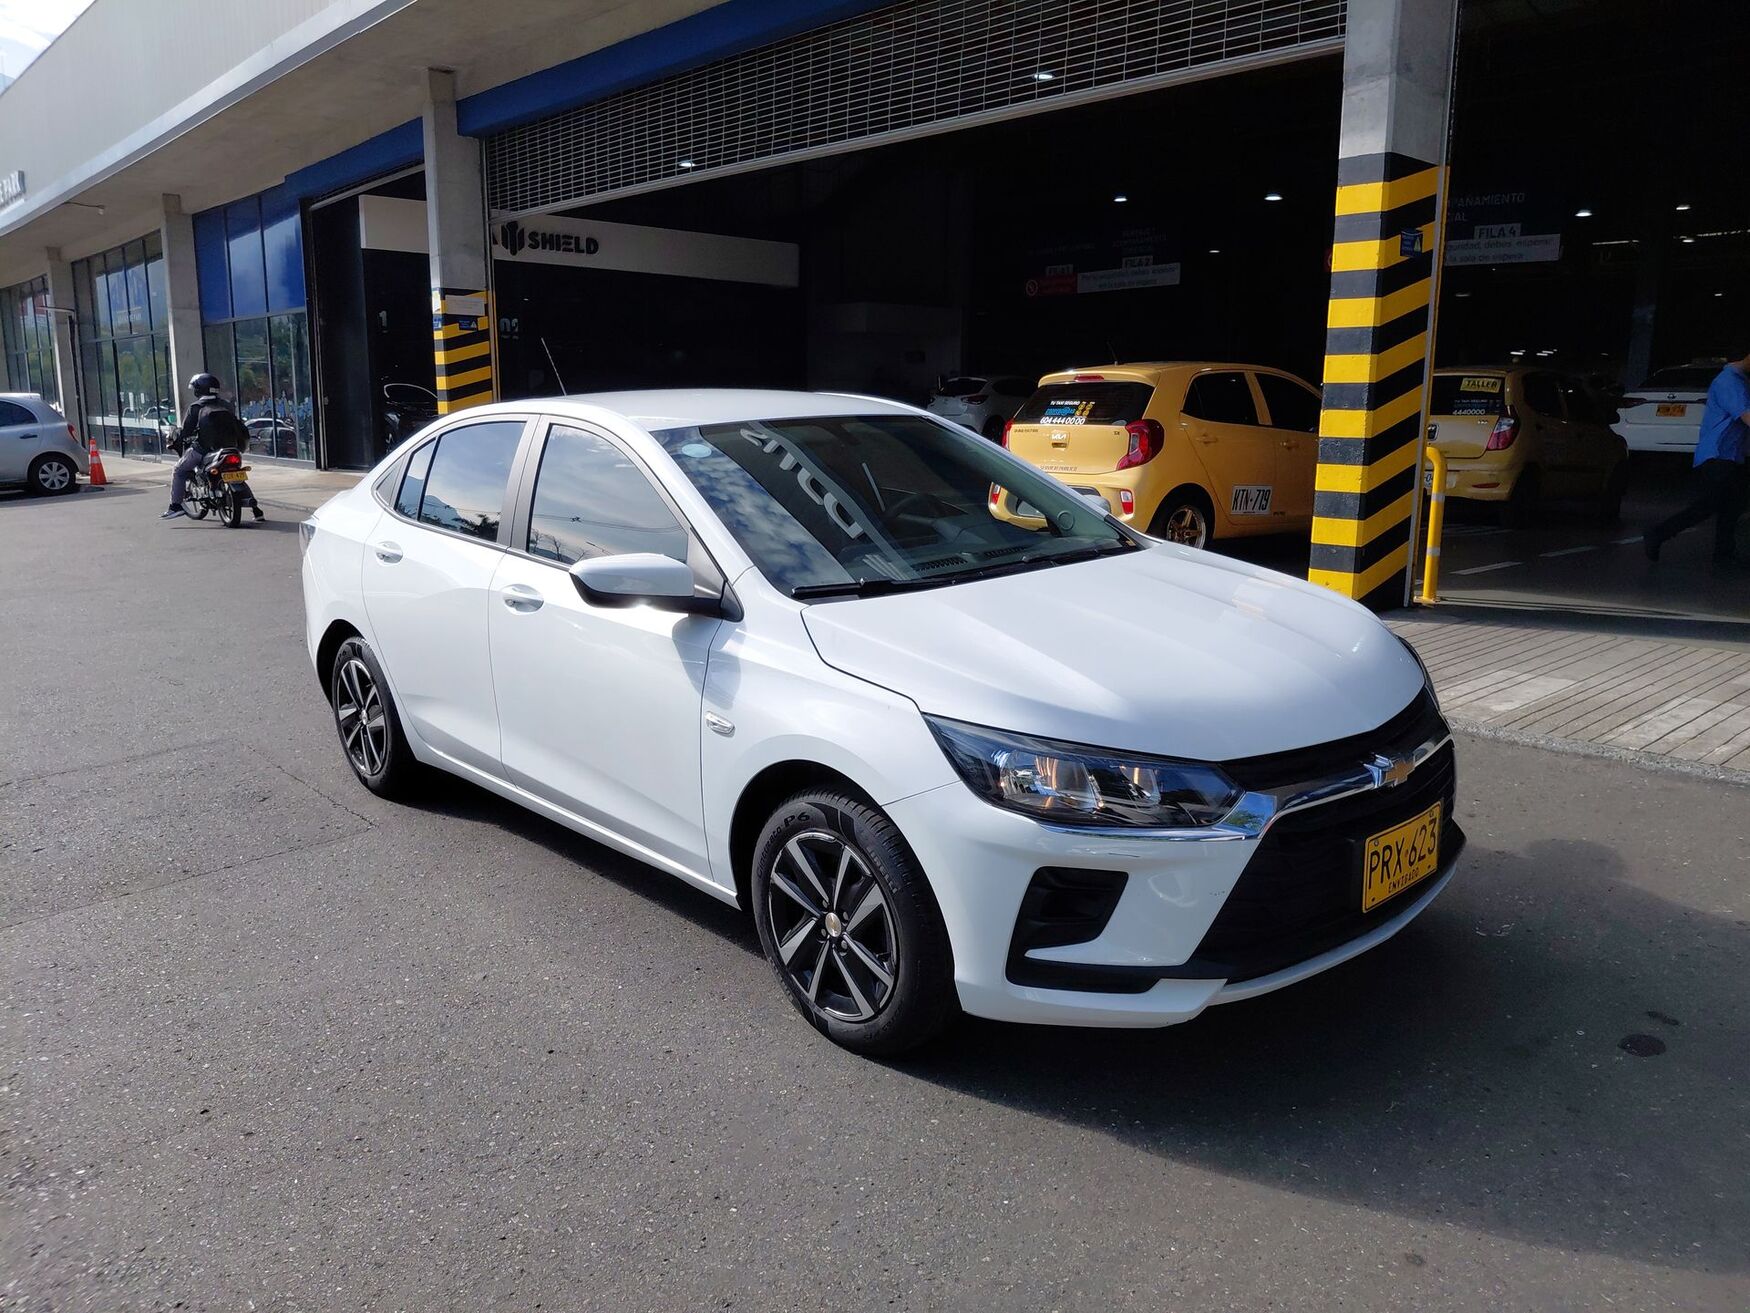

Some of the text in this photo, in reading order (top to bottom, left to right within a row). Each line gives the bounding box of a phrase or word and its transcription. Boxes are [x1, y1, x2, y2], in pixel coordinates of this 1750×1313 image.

[1479, 225, 1517, 239] FILA 4
[528, 231, 599, 255] SHIELD
[1466, 380, 1498, 389] TALLER
[784, 812, 811, 828] P6
[1388, 867, 1420, 893] ENVIGADO
